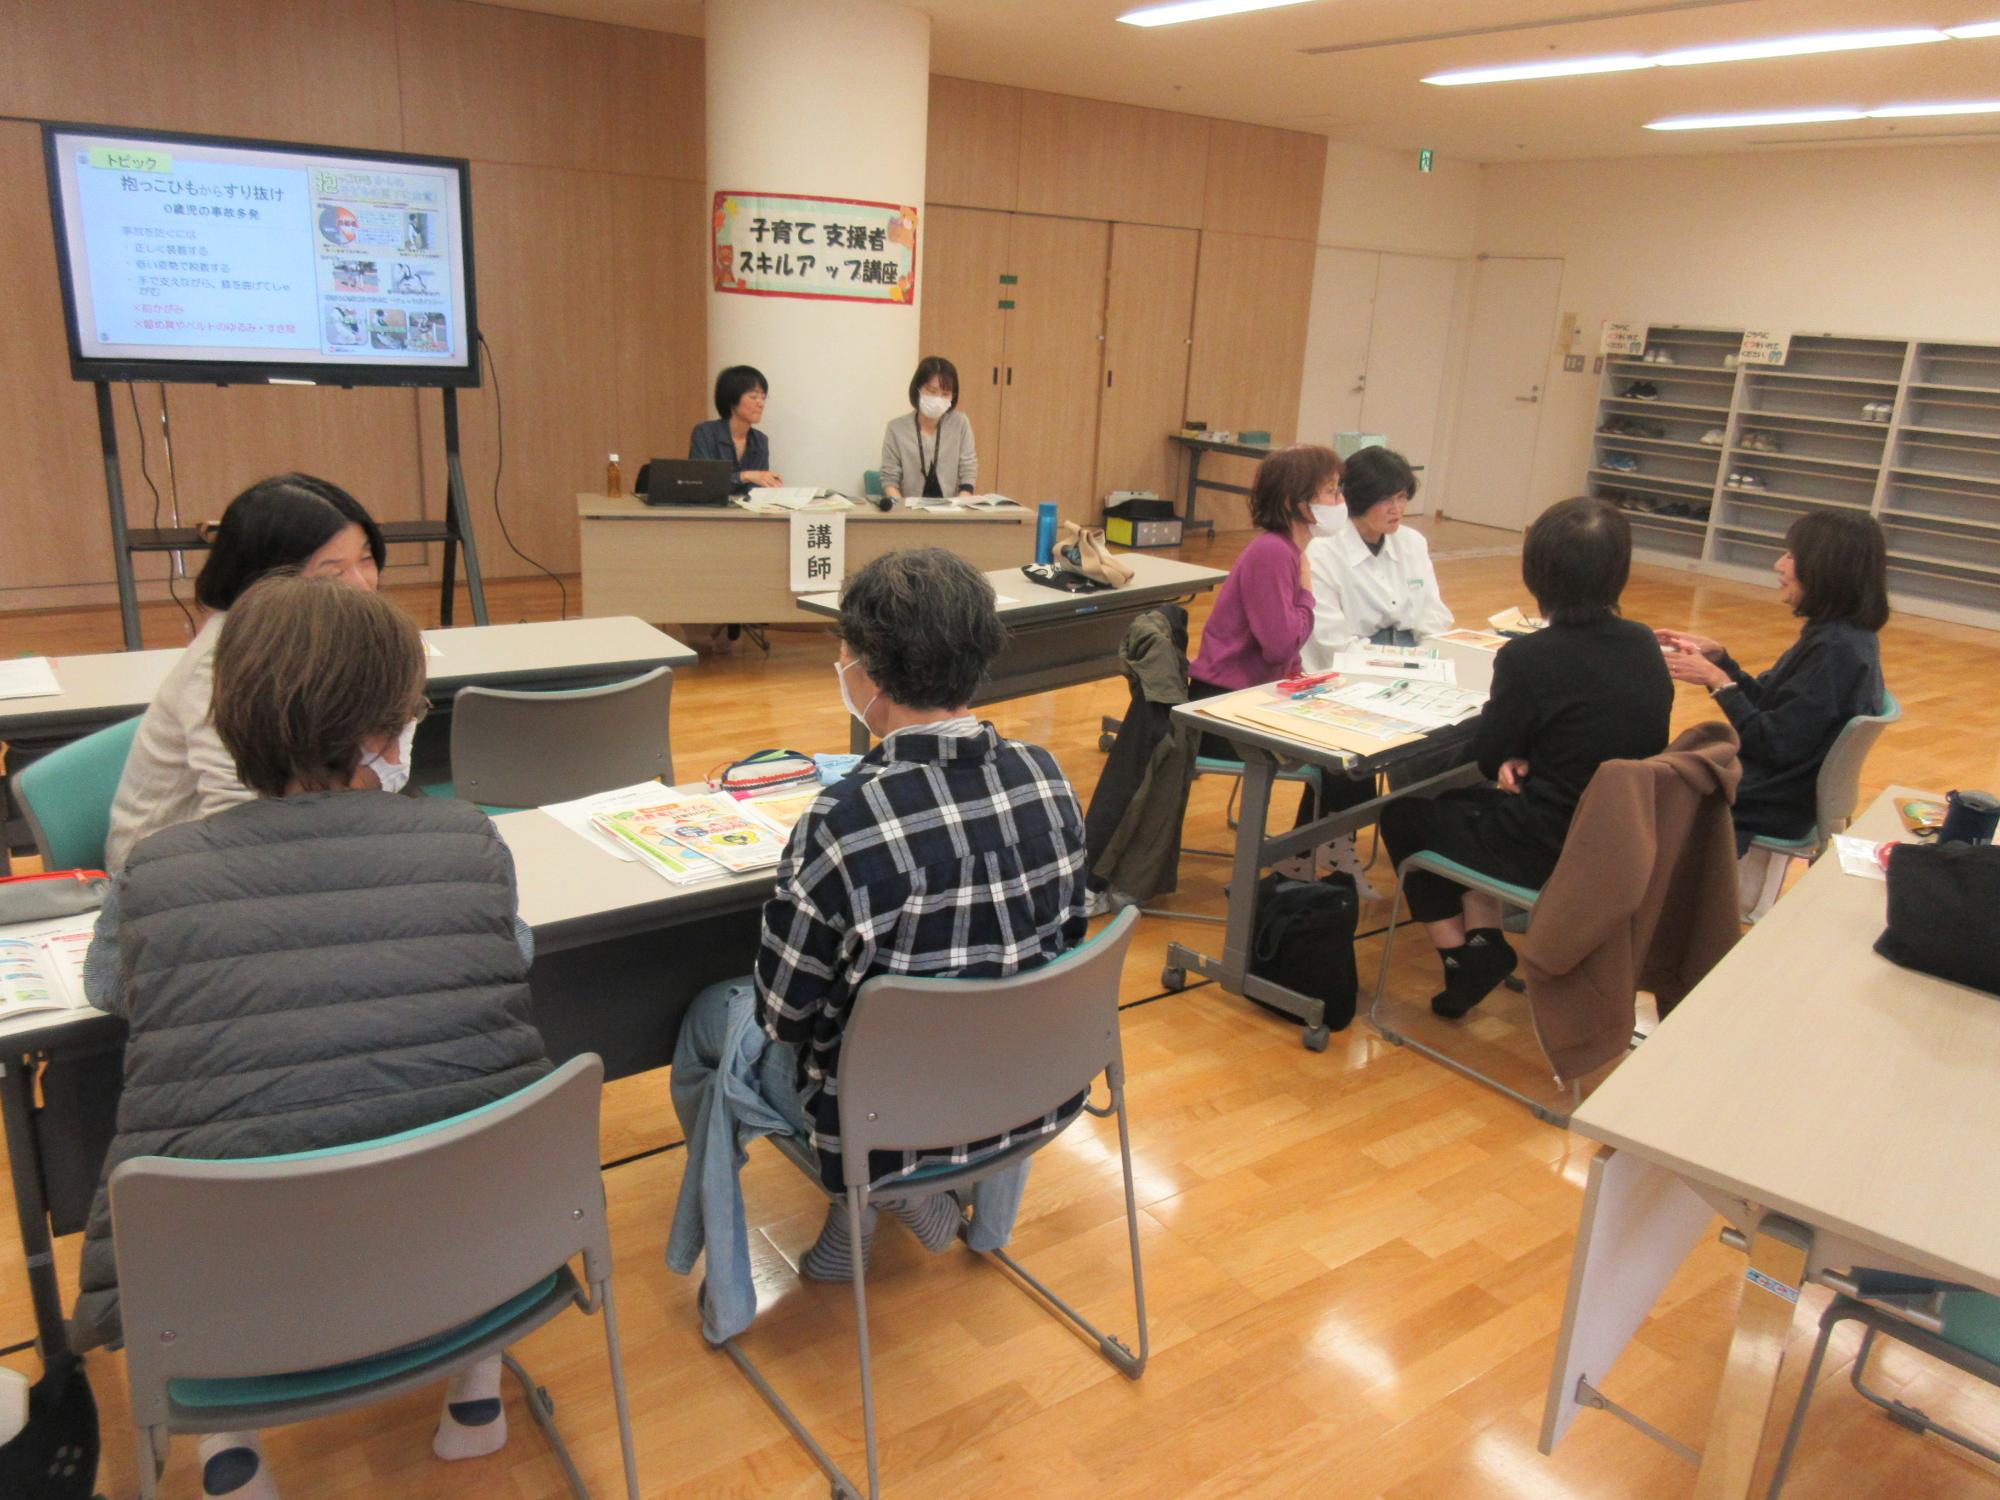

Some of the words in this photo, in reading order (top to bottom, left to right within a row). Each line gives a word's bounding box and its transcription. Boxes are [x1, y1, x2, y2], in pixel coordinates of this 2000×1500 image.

[107, 154, 157, 170] トピック
[121, 175, 284, 202] 抱っこひもからすり抜け
[739, 251, 899, 285] スキルアップ講座
[806, 523, 832, 580] 講師
